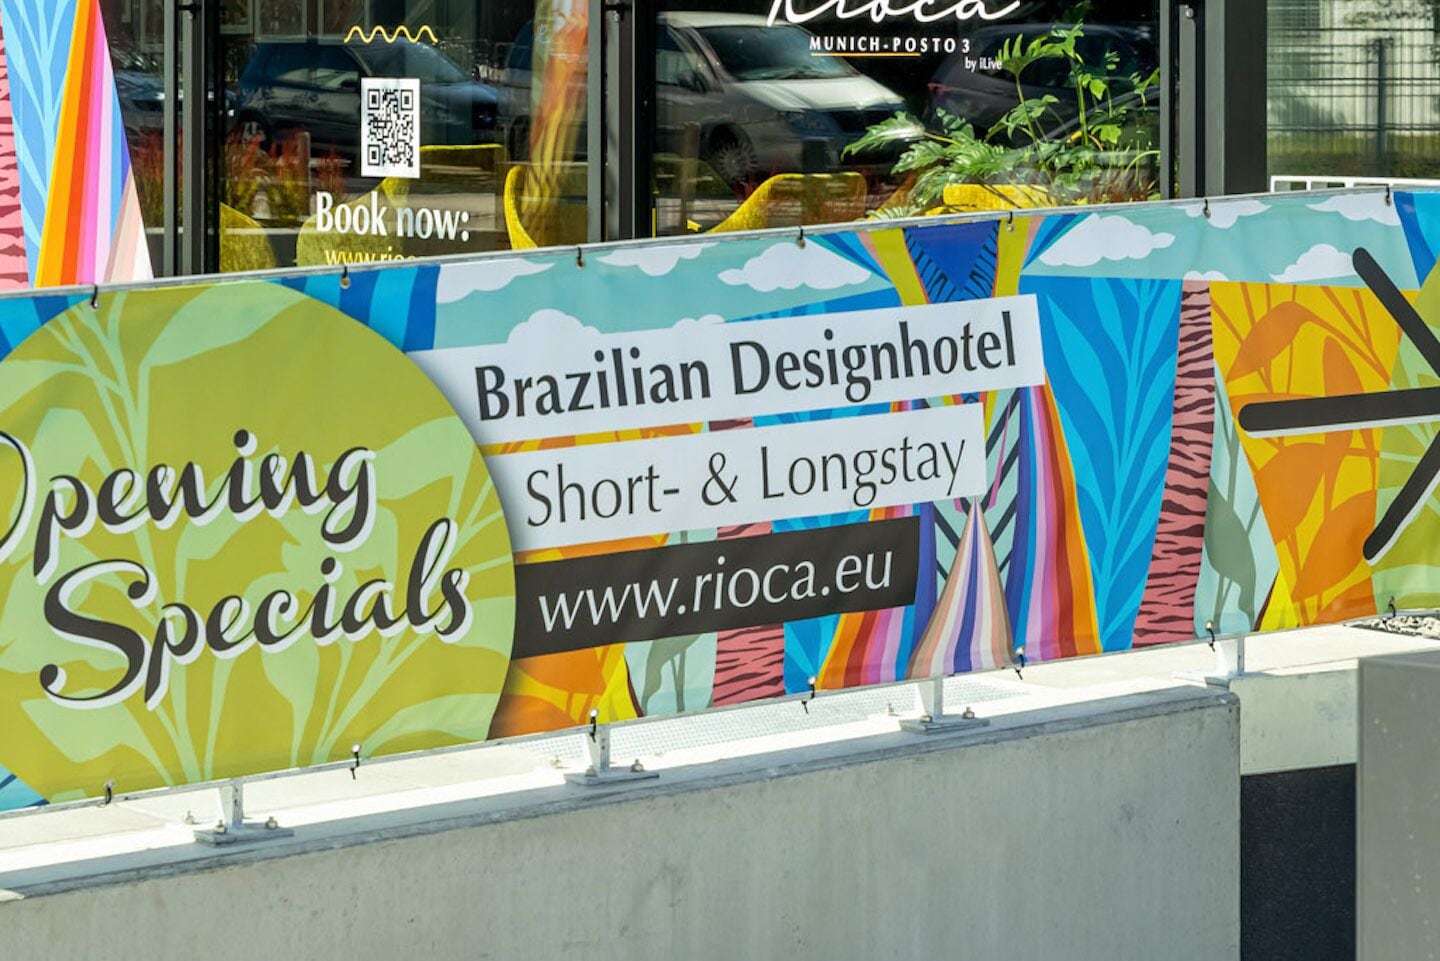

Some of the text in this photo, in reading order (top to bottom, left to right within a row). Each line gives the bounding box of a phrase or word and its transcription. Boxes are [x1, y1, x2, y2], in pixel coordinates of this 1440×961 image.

[962, 38, 971, 54] 3
[964, 56, 1003, 73] by iLive
[316, 191, 470, 242] Book now:
[474, 310, 1019, 422] Brazilian Designhotel
[526, 435, 967, 528] Short- & Longstay
[39, 518, 470, 706] Specials
[537, 550, 894, 634] www.rioca.eu
